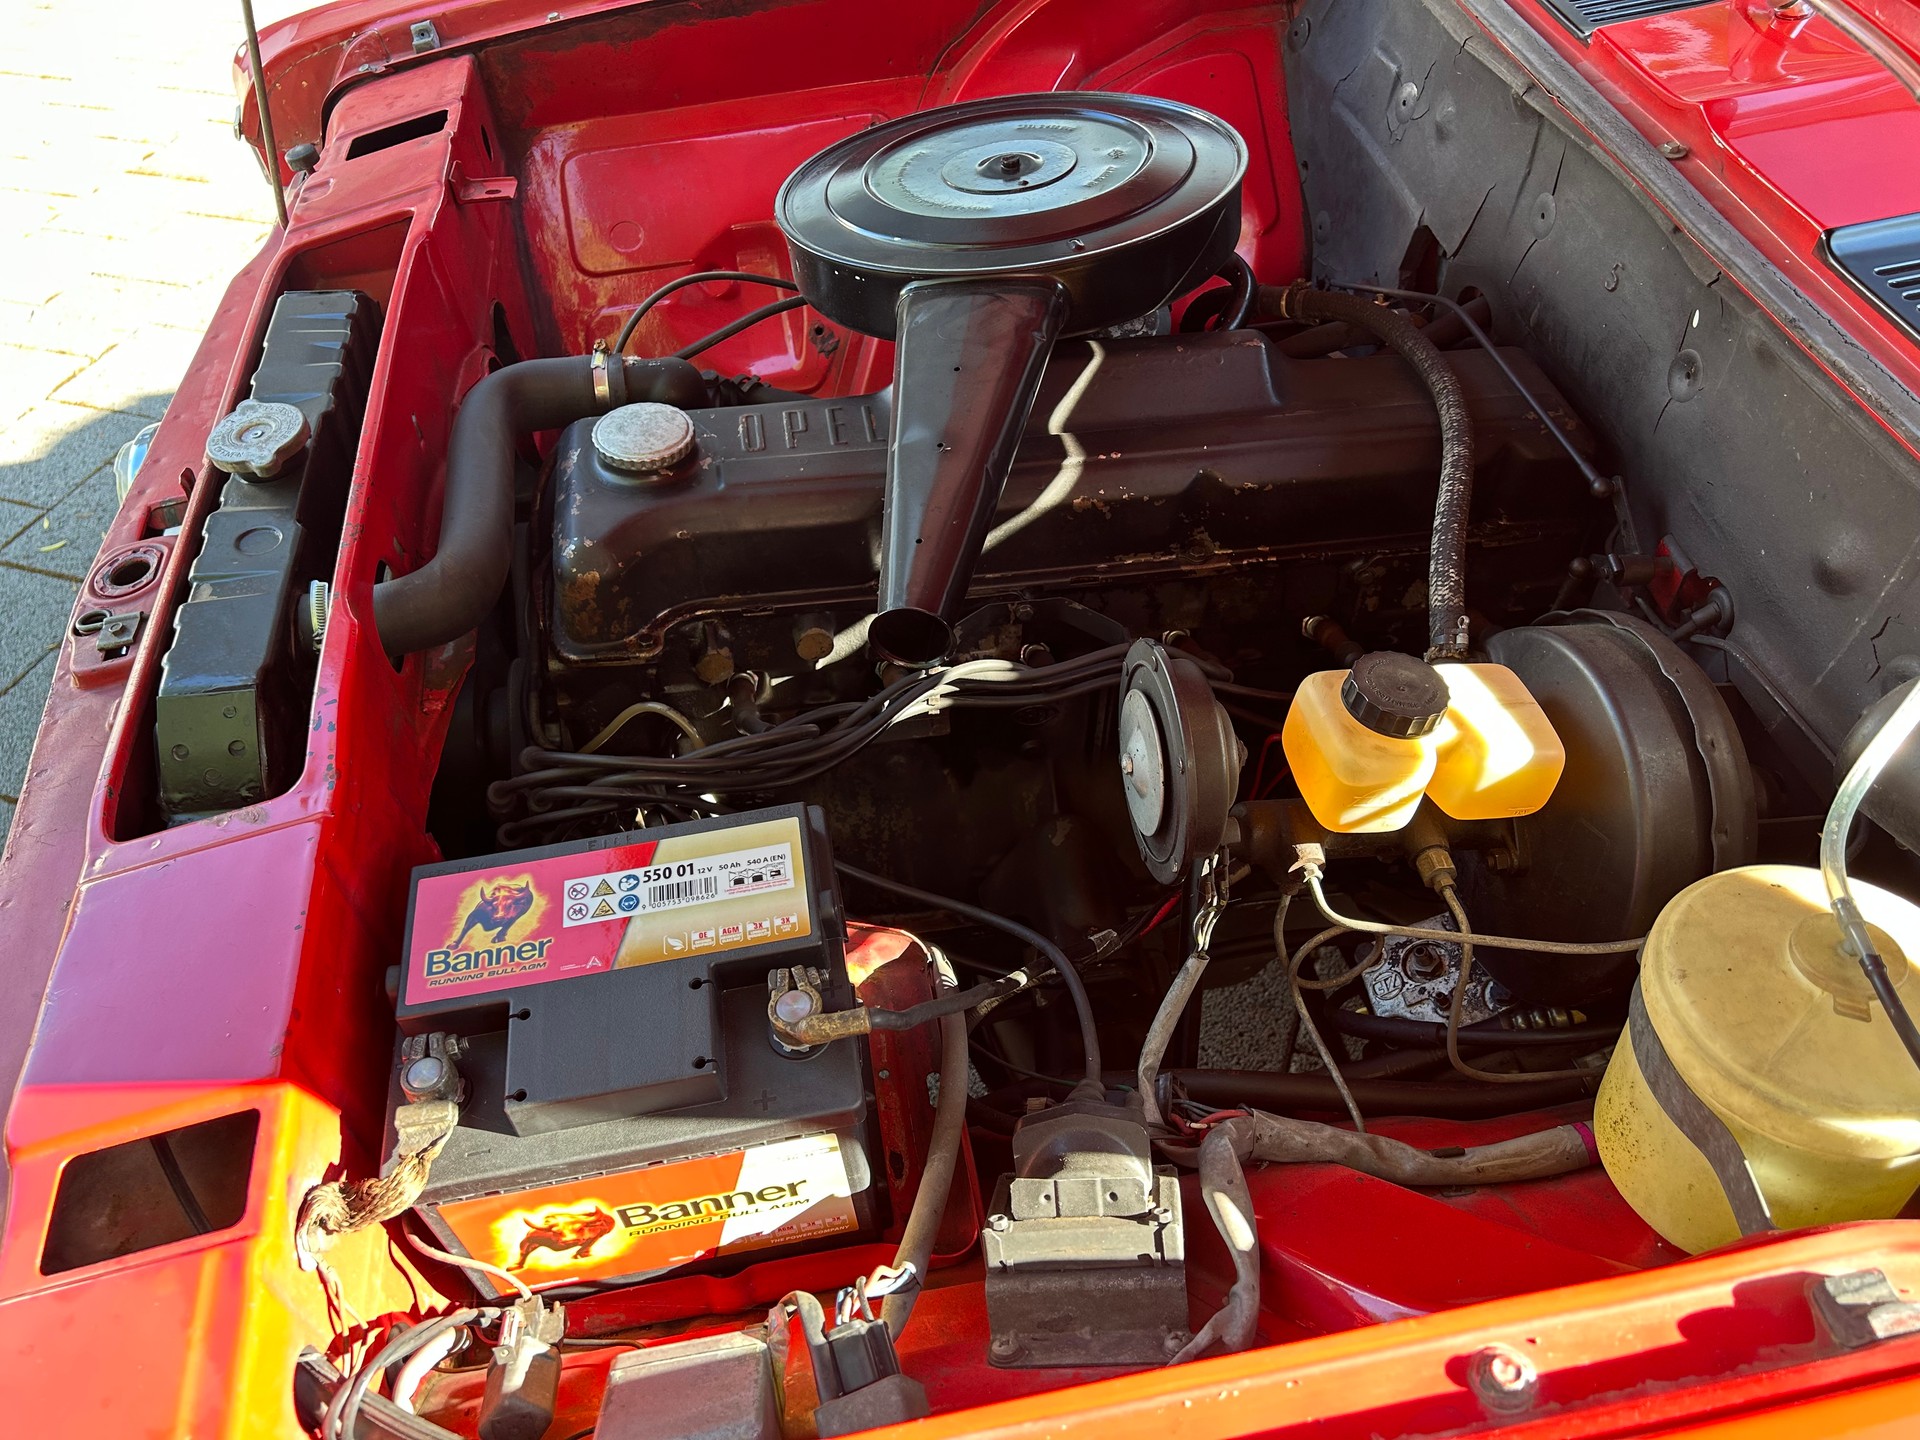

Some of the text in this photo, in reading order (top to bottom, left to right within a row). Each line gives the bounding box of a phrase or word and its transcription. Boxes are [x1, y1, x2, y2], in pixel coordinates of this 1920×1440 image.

[738, 404, 887, 452] OPEL
[643, 866, 672, 883] 550
[677, 862, 695, 877] 01
[697, 867, 706, 875] 12
[729, 861, 741, 869] Ah
[747, 857, 762, 866] 540
[770, 853, 787, 862] (EN)
[722, 926, 740, 935] AGM
[780, 917, 791, 925] 3X
[426, 938, 553, 977] Banner
[429, 972, 485, 987] RUNNING
[488, 967, 517, 977] BULL
[518, 961, 547, 972] AGM
[617, 1179, 807, 1228] Banner
[629, 1198, 810, 1237] RUNNING BULL AGM
[770, 1224, 850, 1244] THE POWER COMPANY
